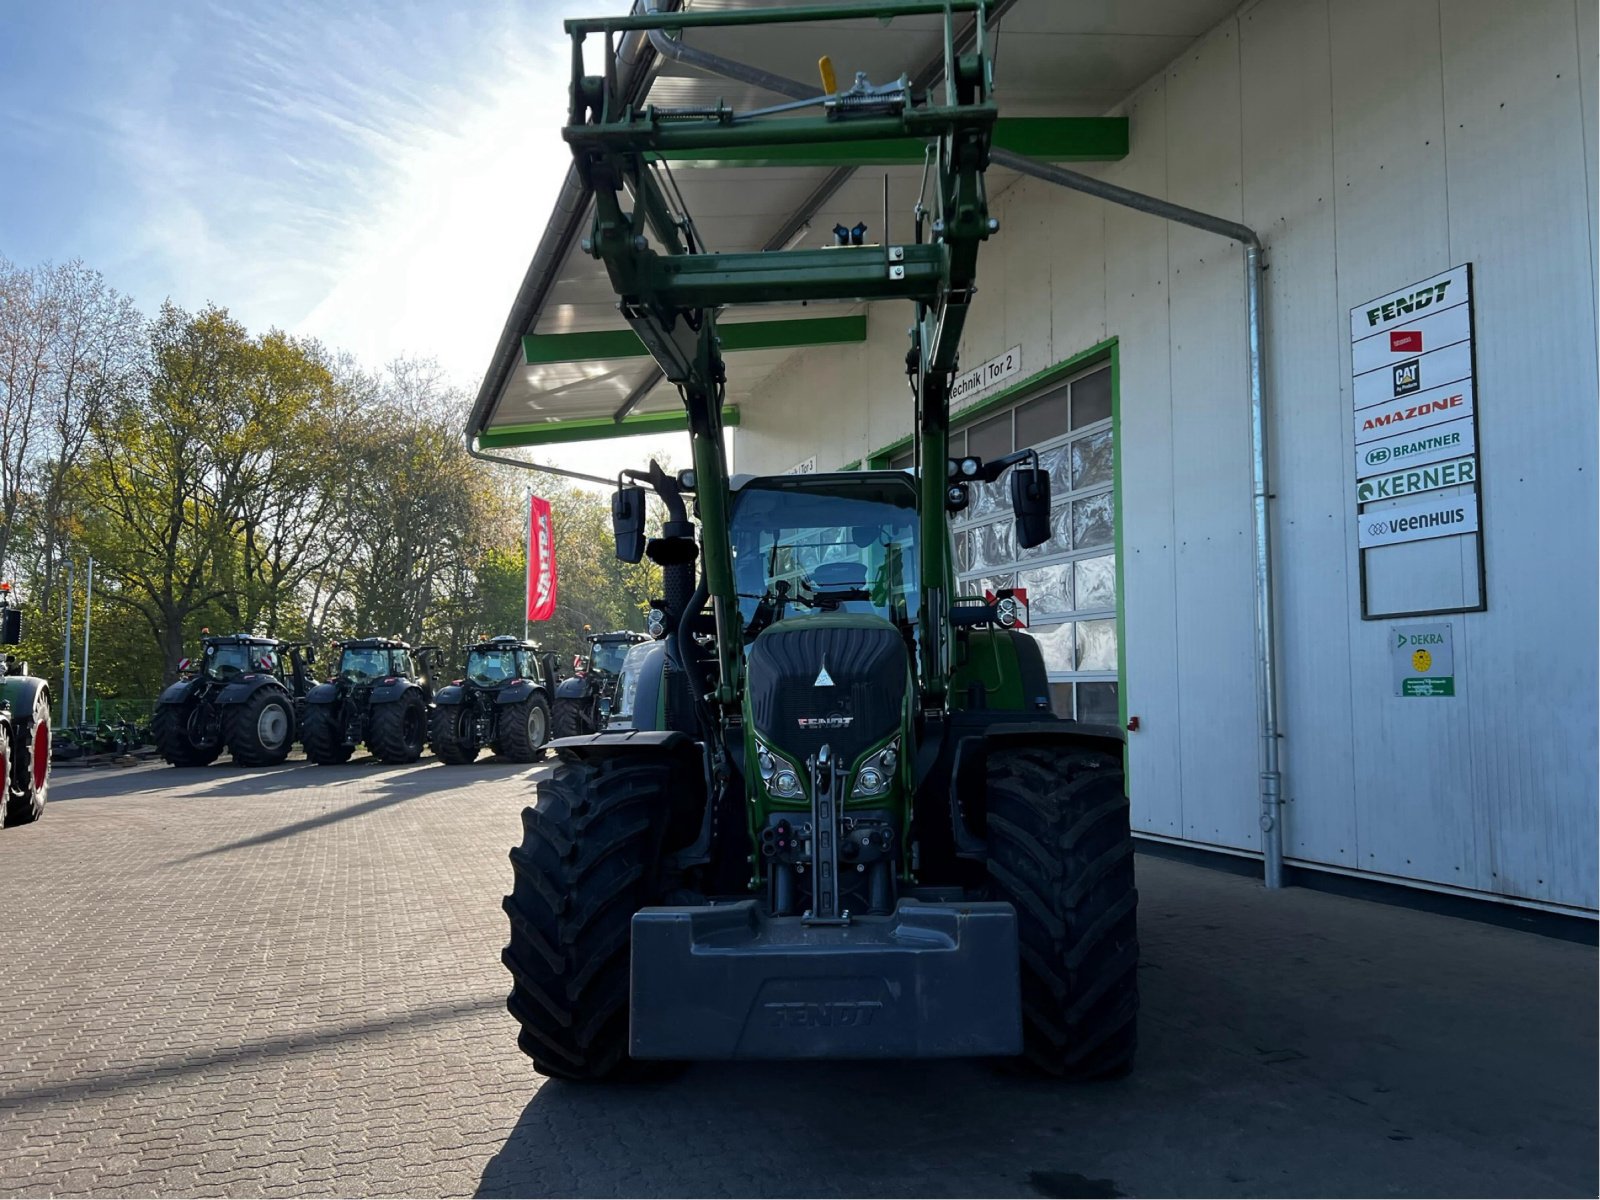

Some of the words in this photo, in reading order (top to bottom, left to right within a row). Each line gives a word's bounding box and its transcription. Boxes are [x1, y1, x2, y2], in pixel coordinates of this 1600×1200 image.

[1366, 279, 1452, 327] FENDT
[988, 362, 1004, 379] Tor
[1006, 355, 1013, 371] 2
[1395, 364, 1418, 385] CAT
[1362, 393, 1463, 431] AMAZONE
[1393, 432, 1461, 458] BRANTNER
[1377, 461, 1474, 498] KERNER
[1410, 633, 1444, 645] DEKRA
[797, 717, 854, 729] FENDT
[764, 1001, 883, 1027] FENDT
